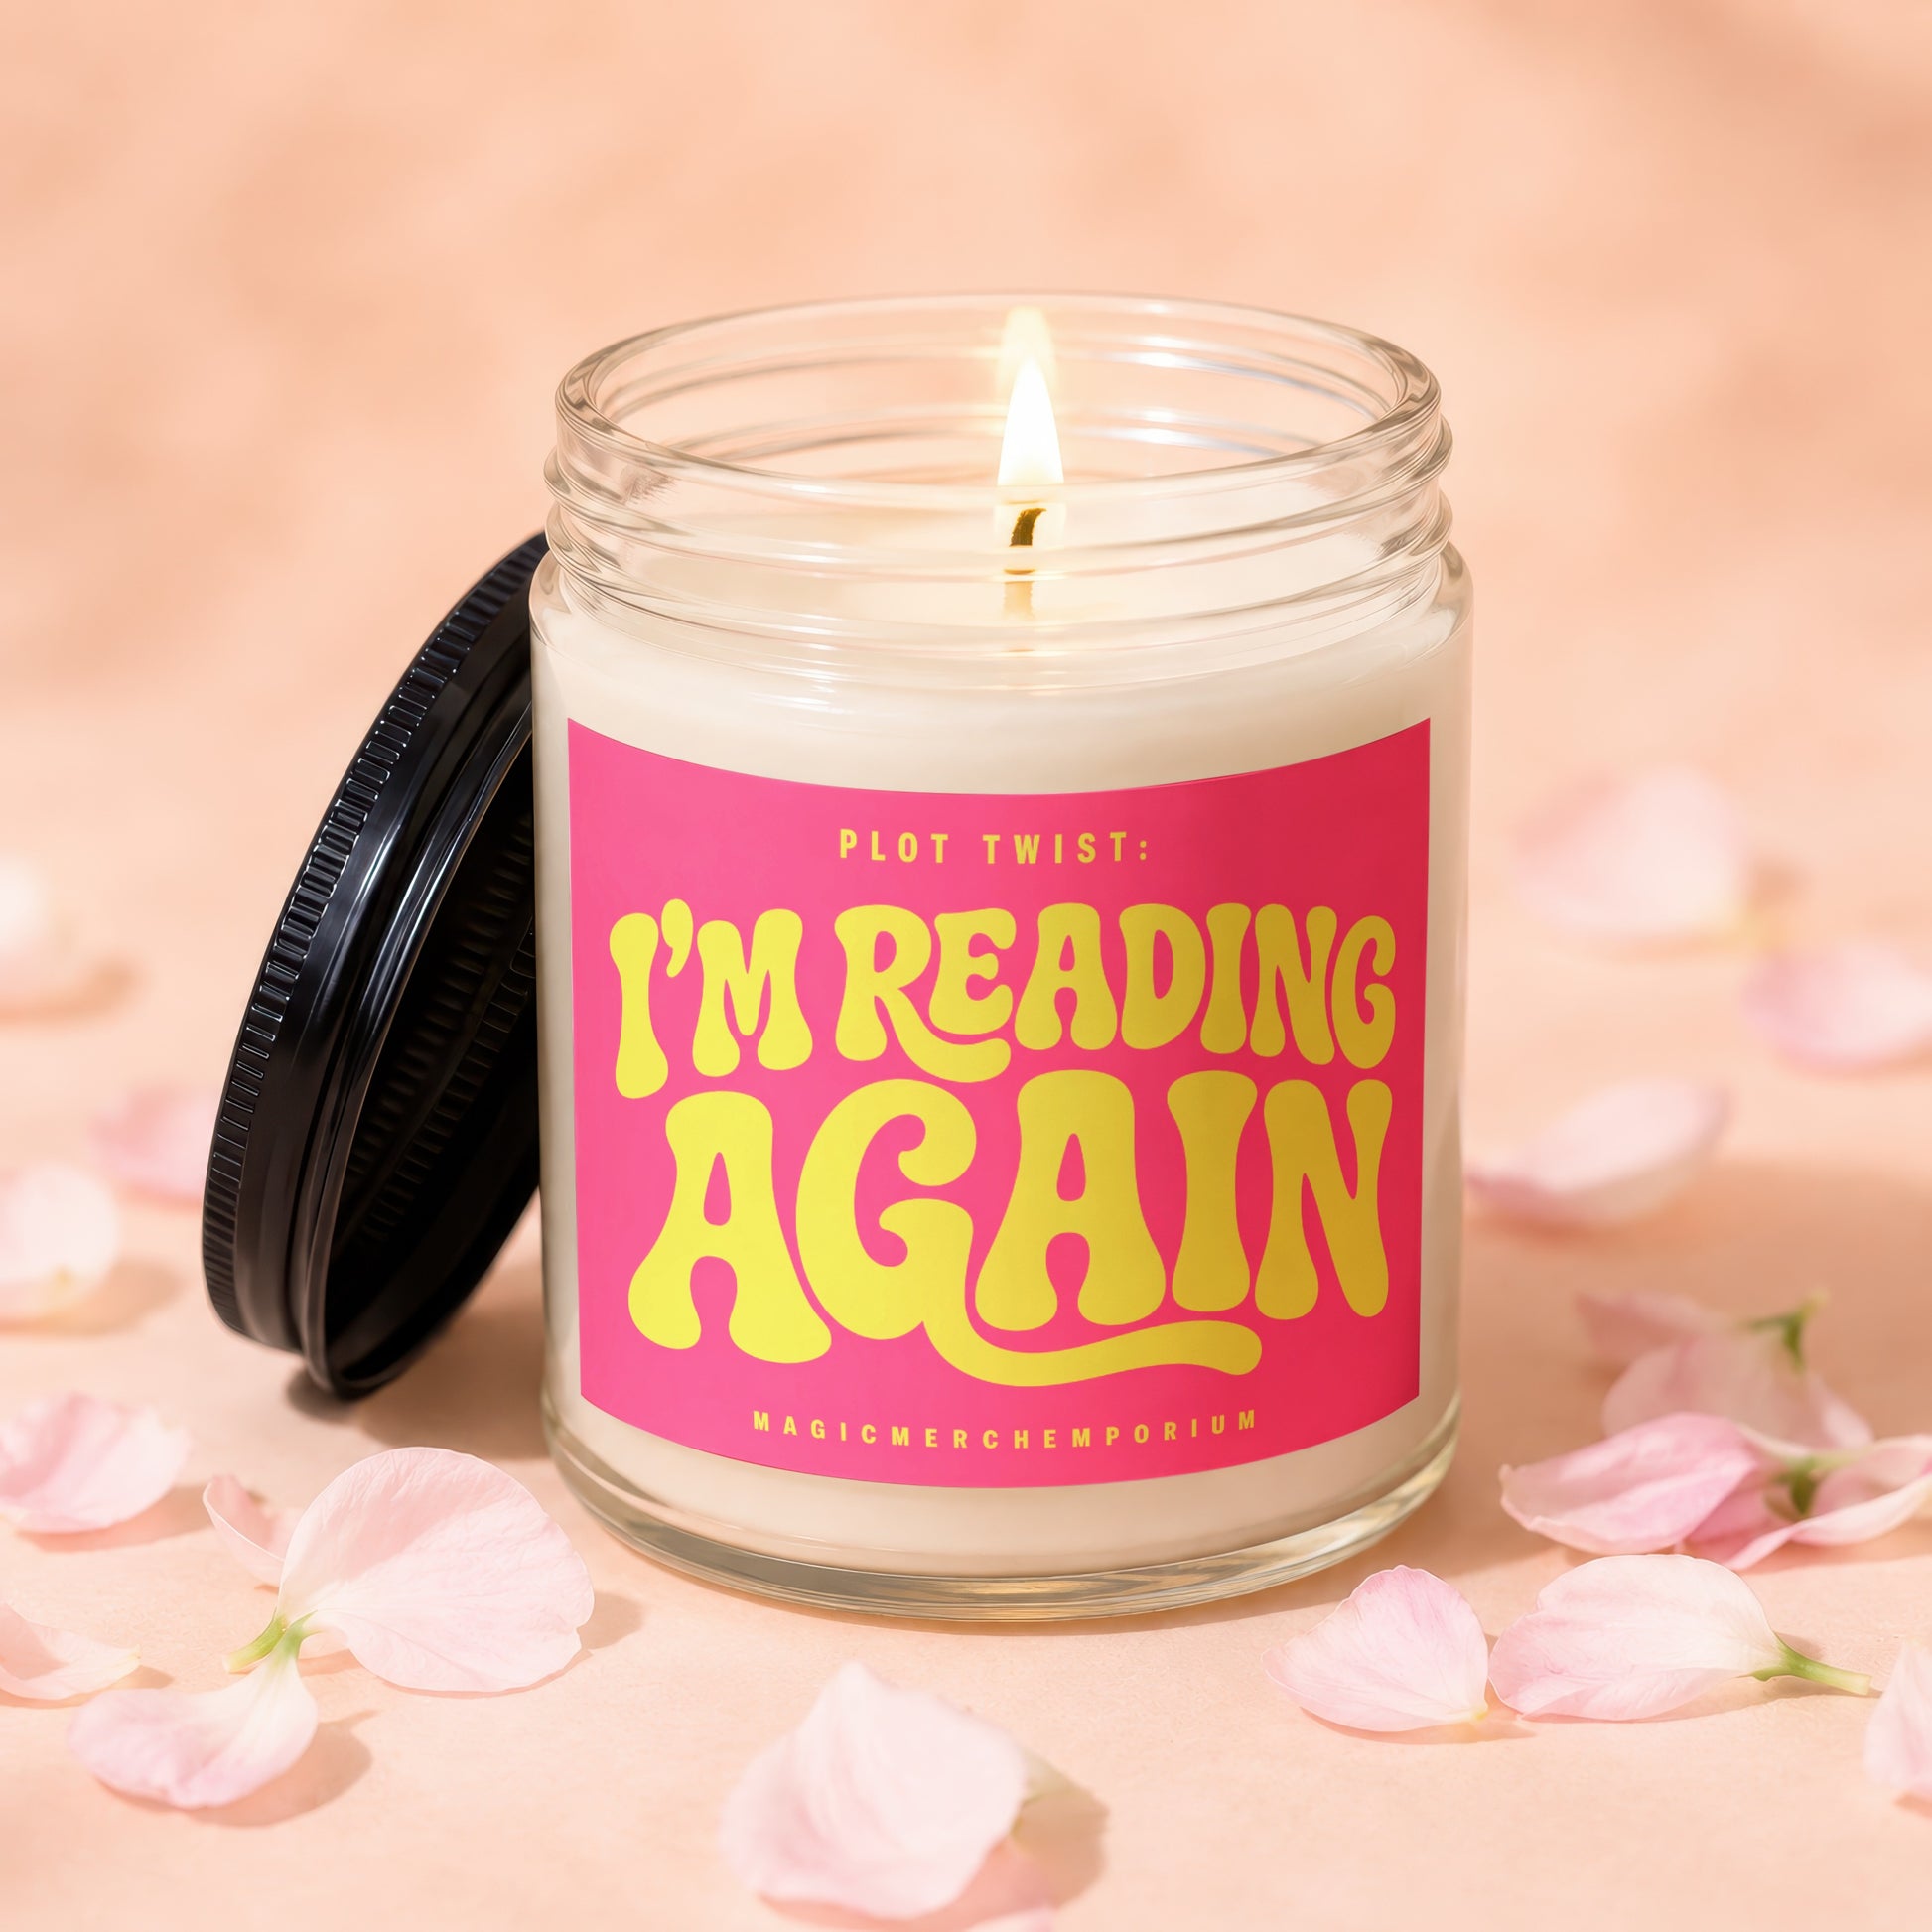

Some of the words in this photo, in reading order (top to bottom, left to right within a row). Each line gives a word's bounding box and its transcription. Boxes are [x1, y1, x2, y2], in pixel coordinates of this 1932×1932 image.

[839, 828, 950, 865] PLOT
[982, 831, 1150, 866] TWIST:
[609, 898, 813, 1099] I'M
[834, 902, 1397, 1083] READING
[627, 1069, 1393, 1388] AGAIN
[752, 1409, 1257, 1449] MAGICMERCHEMPORIUM
